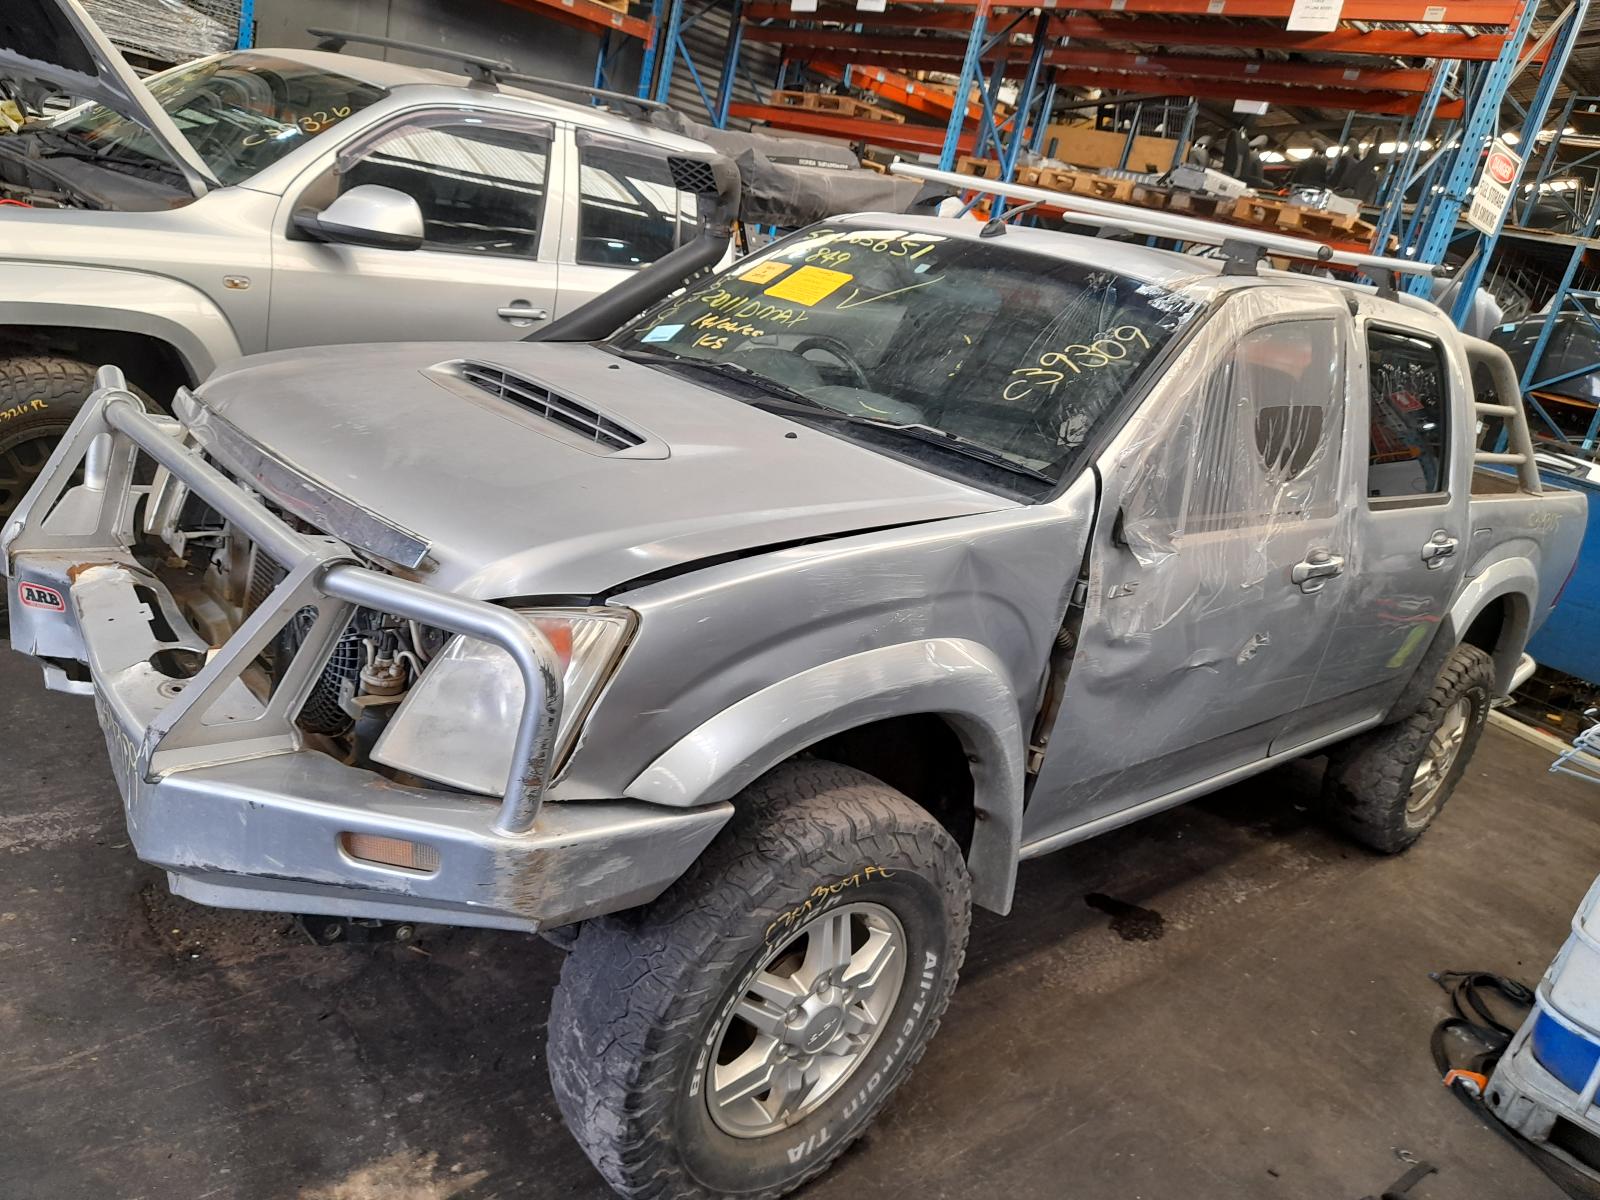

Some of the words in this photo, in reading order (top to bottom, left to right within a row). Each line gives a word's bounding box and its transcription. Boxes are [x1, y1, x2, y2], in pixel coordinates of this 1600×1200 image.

[1491, 157, 1512, 179] DANGER
[1487, 186, 1507, 210] STORAGE
[1478, 206, 1497, 229] SMOKING
[1003, 326, 1151, 400] C39309
[25, 587, 60, 606] ARB
[842, 951, 938, 1120] All-Terrain
[787, 1127, 832, 1164] T/A
